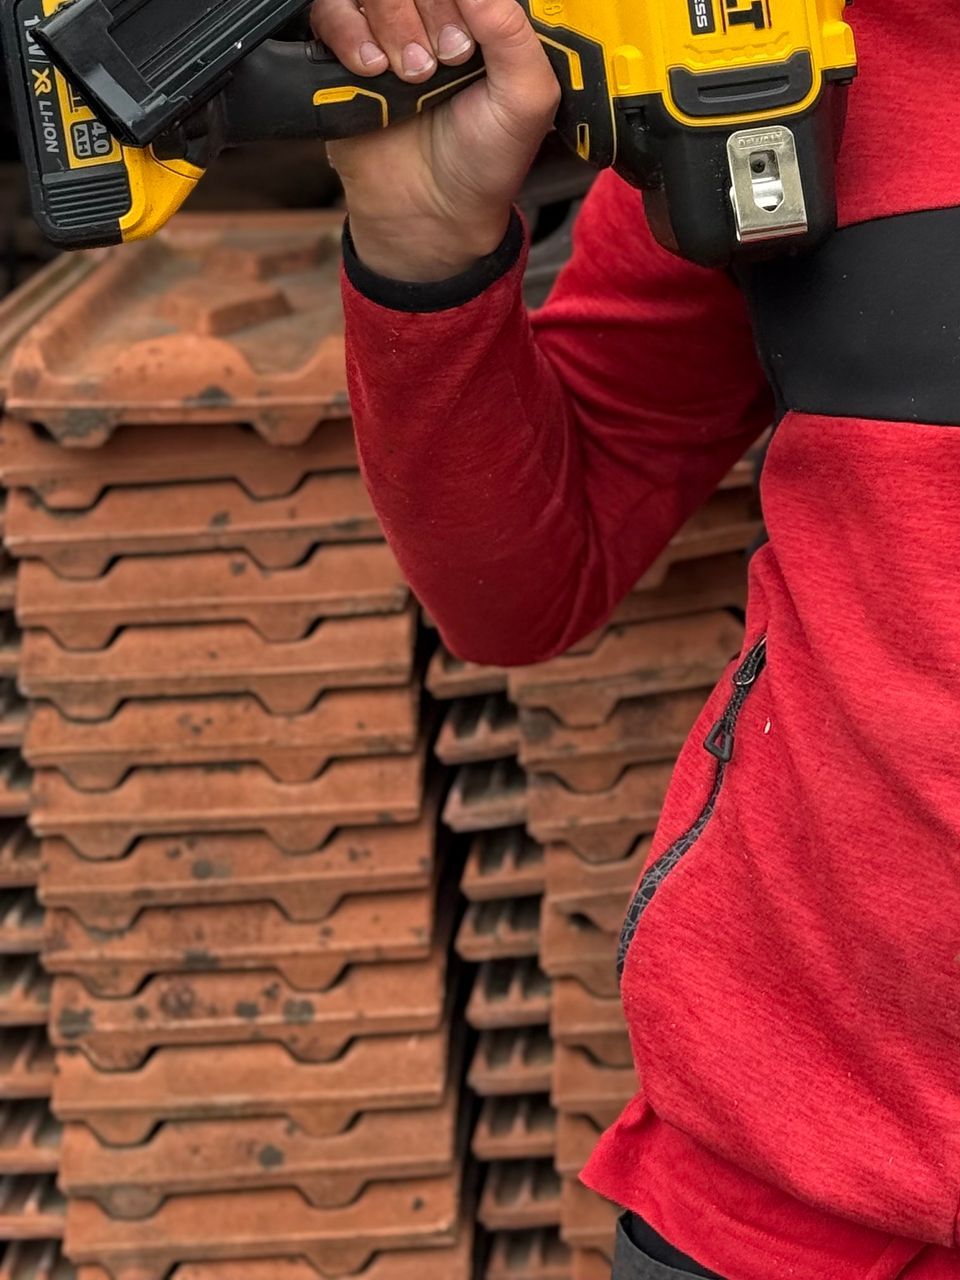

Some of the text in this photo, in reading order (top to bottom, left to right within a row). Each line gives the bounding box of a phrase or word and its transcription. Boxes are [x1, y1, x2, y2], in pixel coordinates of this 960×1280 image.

[31, 67, 52, 97] XR
[39, 101, 59, 153] LI-ION
[91, 122, 110, 154] 4.0
